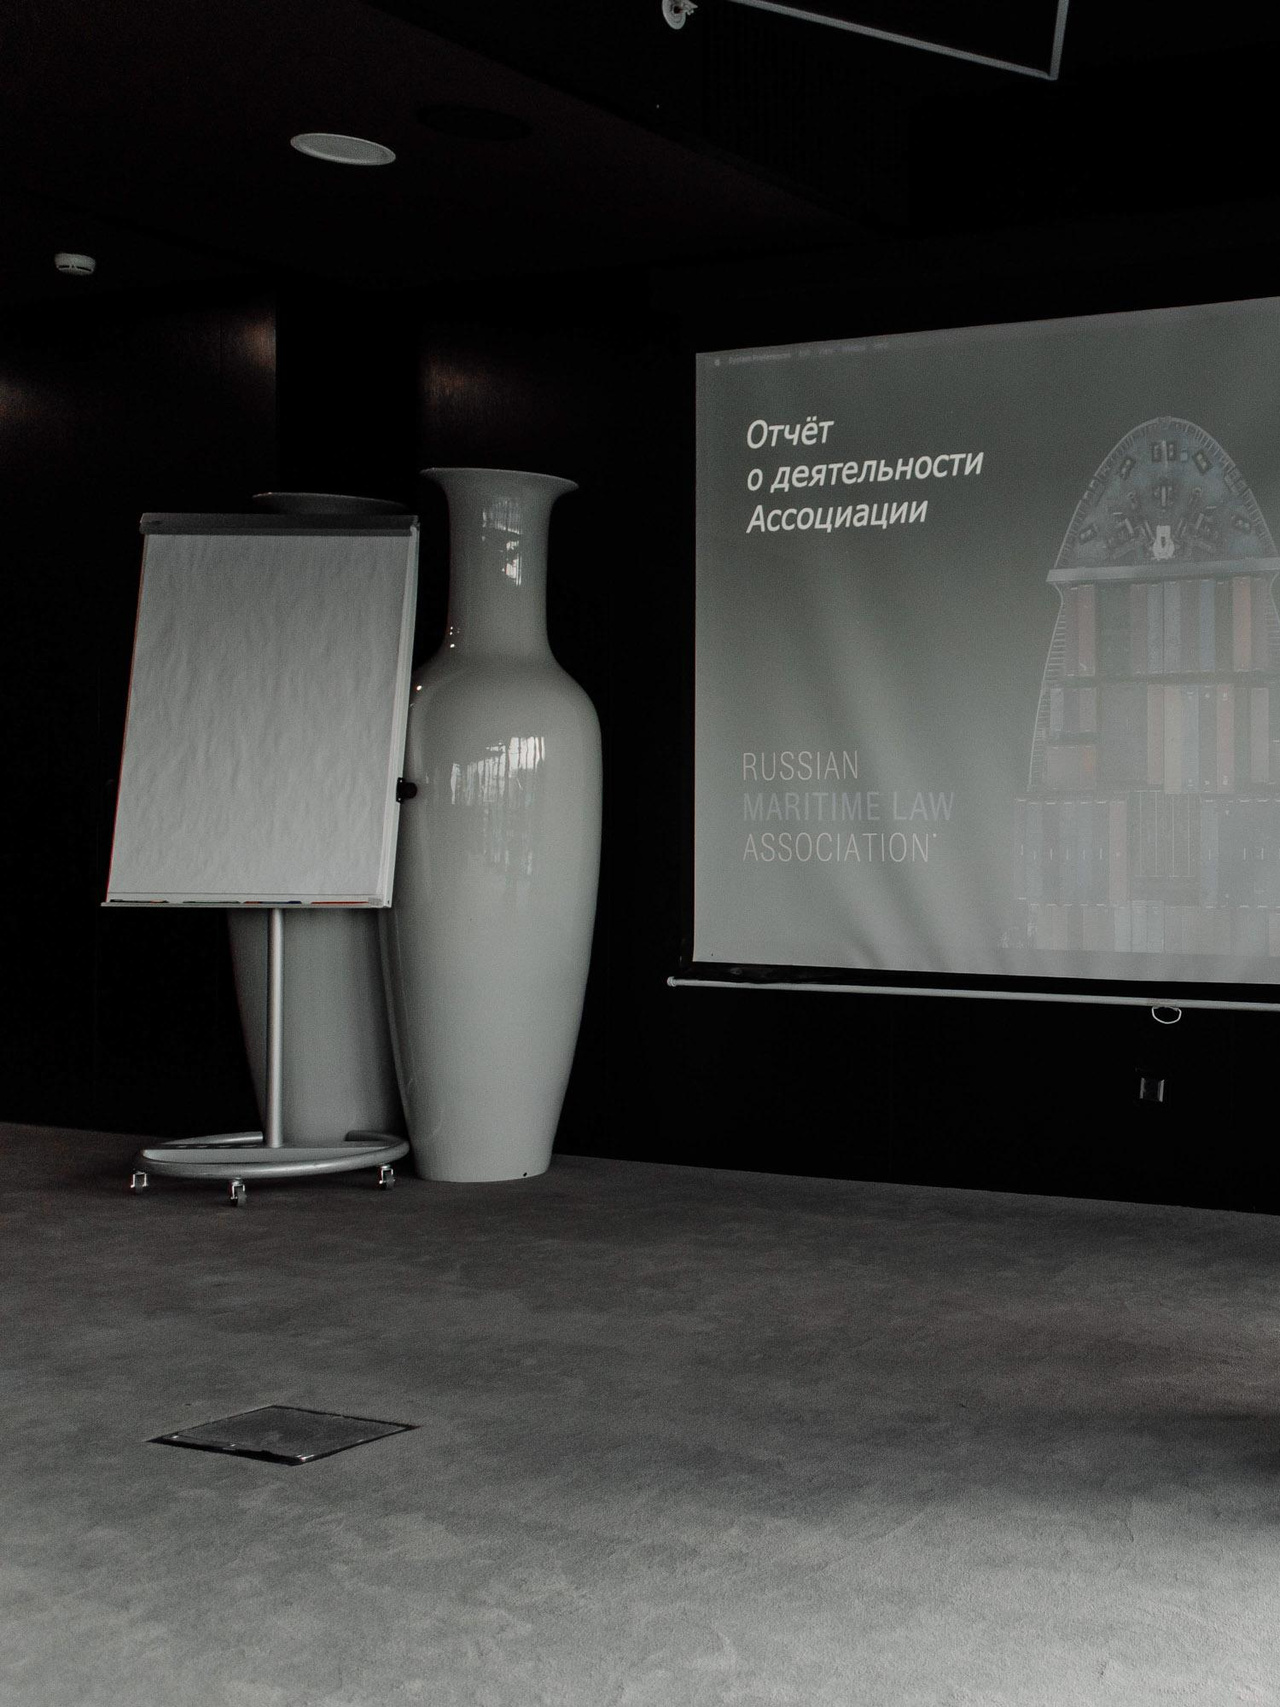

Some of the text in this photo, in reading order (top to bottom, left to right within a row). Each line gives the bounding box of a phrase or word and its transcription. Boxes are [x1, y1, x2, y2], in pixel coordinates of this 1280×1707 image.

[746, 415, 835, 450] Отчёт
[746, 451, 985, 494] о деятельности
[745, 500, 929, 534] Ассоциации
[742, 750, 859, 782] RUSSIAN
[742, 790, 956, 822] MARITIME LAW
[742, 831, 930, 863] ASSOCIATION
